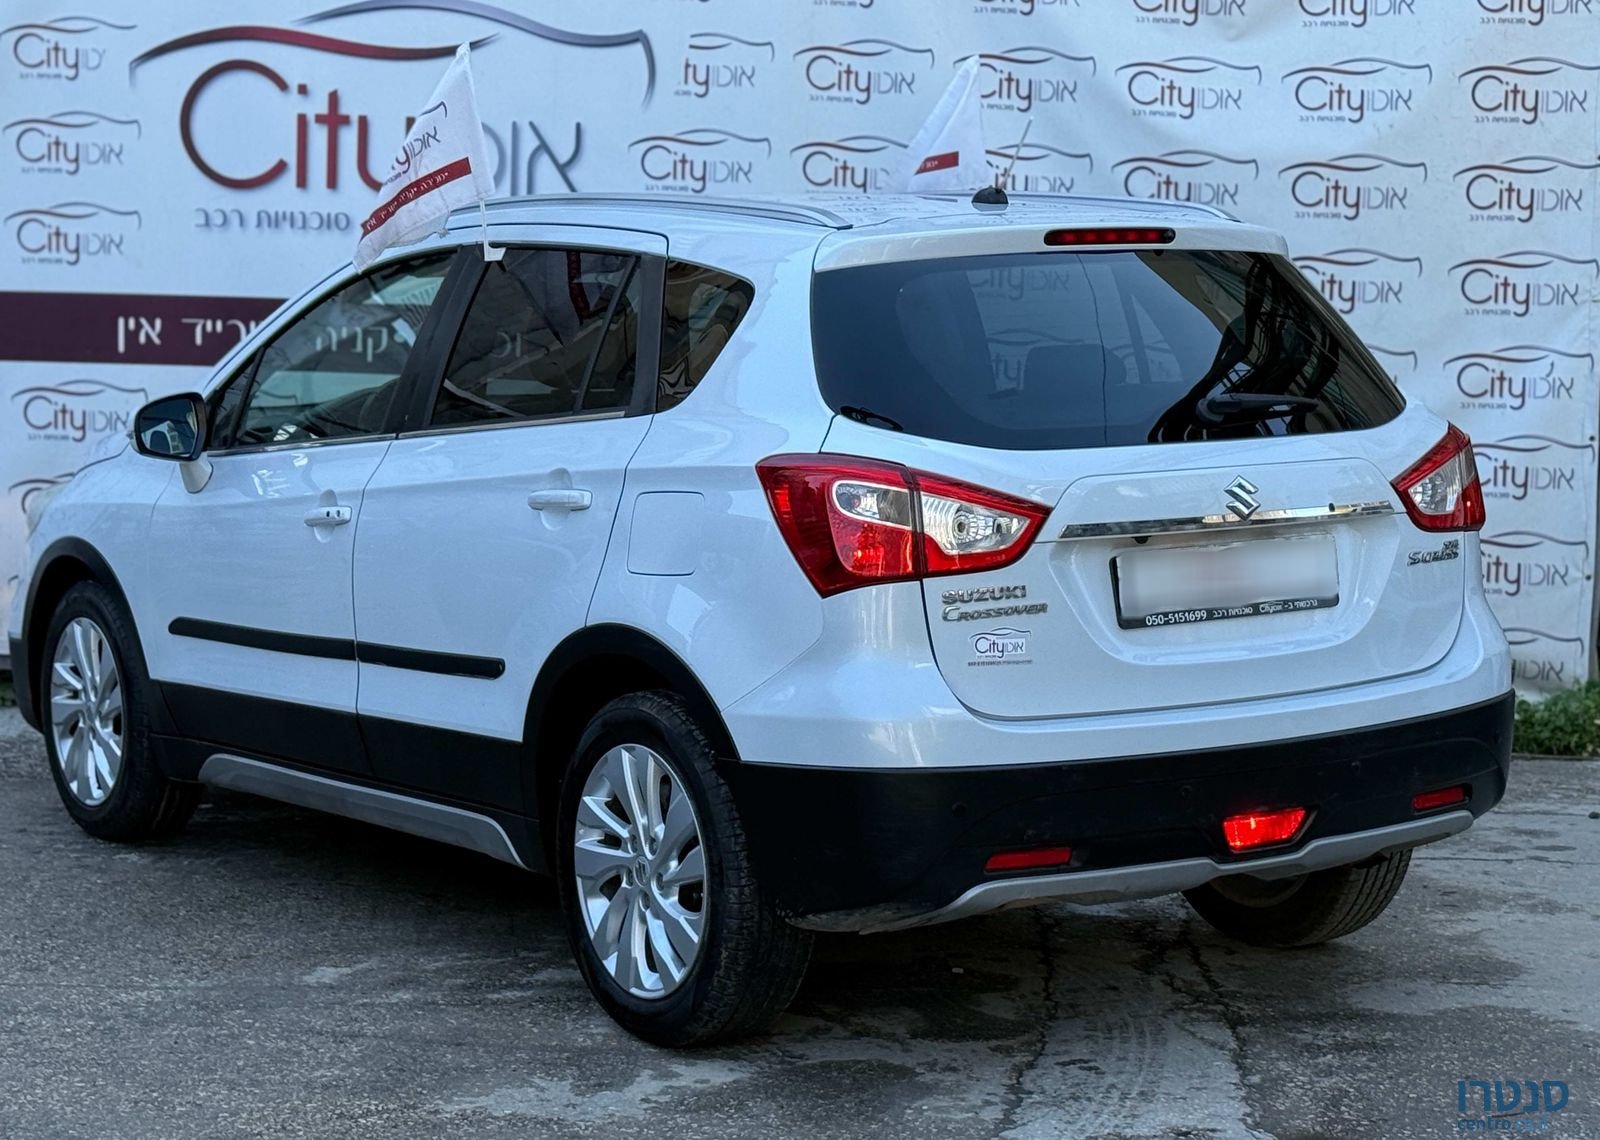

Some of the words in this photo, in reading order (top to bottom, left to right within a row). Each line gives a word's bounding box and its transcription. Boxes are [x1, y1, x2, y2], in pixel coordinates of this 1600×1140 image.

[14, 33, 79, 81] City
[806, 55, 871, 105] City
[1128, 70, 1194, 119] City
[1295, 76, 1364, 123] City
[1471, 75, 1539, 124] City
[16, 127, 79, 175] City
[641, 145, 706, 193] City
[802, 151, 868, 193] City
[1124, 166, 1192, 203] City
[1292, 171, 1360, 220] City
[1466, 174, 1534, 223] City
[17, 218, 79, 266] City
[195, 207, 244, 229] רכב
[255, 209, 350, 231] סוכנויות
[1461, 268, 1530, 317] City
[117, 316, 162, 354] אין
[1457, 362, 1525, 411] City
[24, 396, 86, 442] City
[942, 585, 1027, 605] SUZUKI
[1145, 610, 1207, 626] 050-5151699
[974, 636, 1005, 658] City
